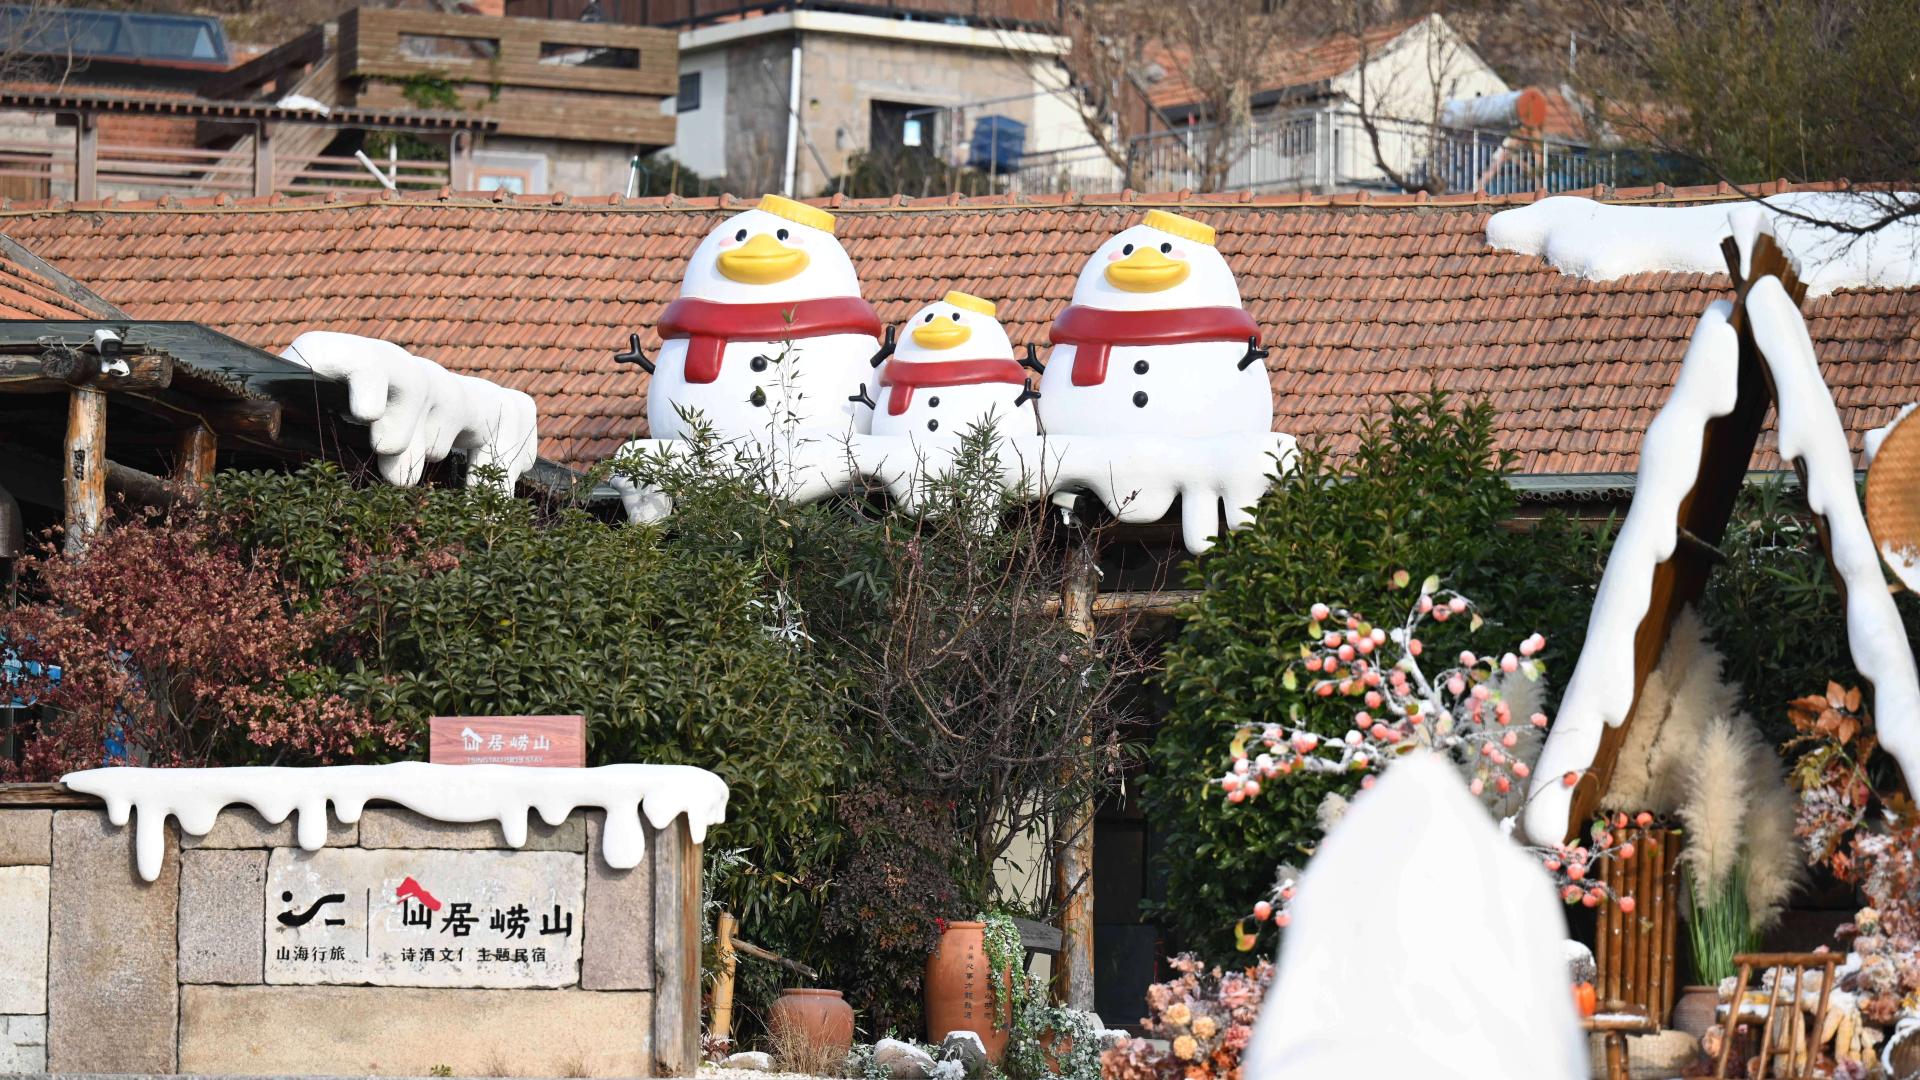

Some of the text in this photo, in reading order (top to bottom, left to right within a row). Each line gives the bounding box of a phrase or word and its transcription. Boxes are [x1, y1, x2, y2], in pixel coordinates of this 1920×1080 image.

[396, 876, 573, 939] 仙居崂山
[276, 945, 346, 962] 山海行旅
